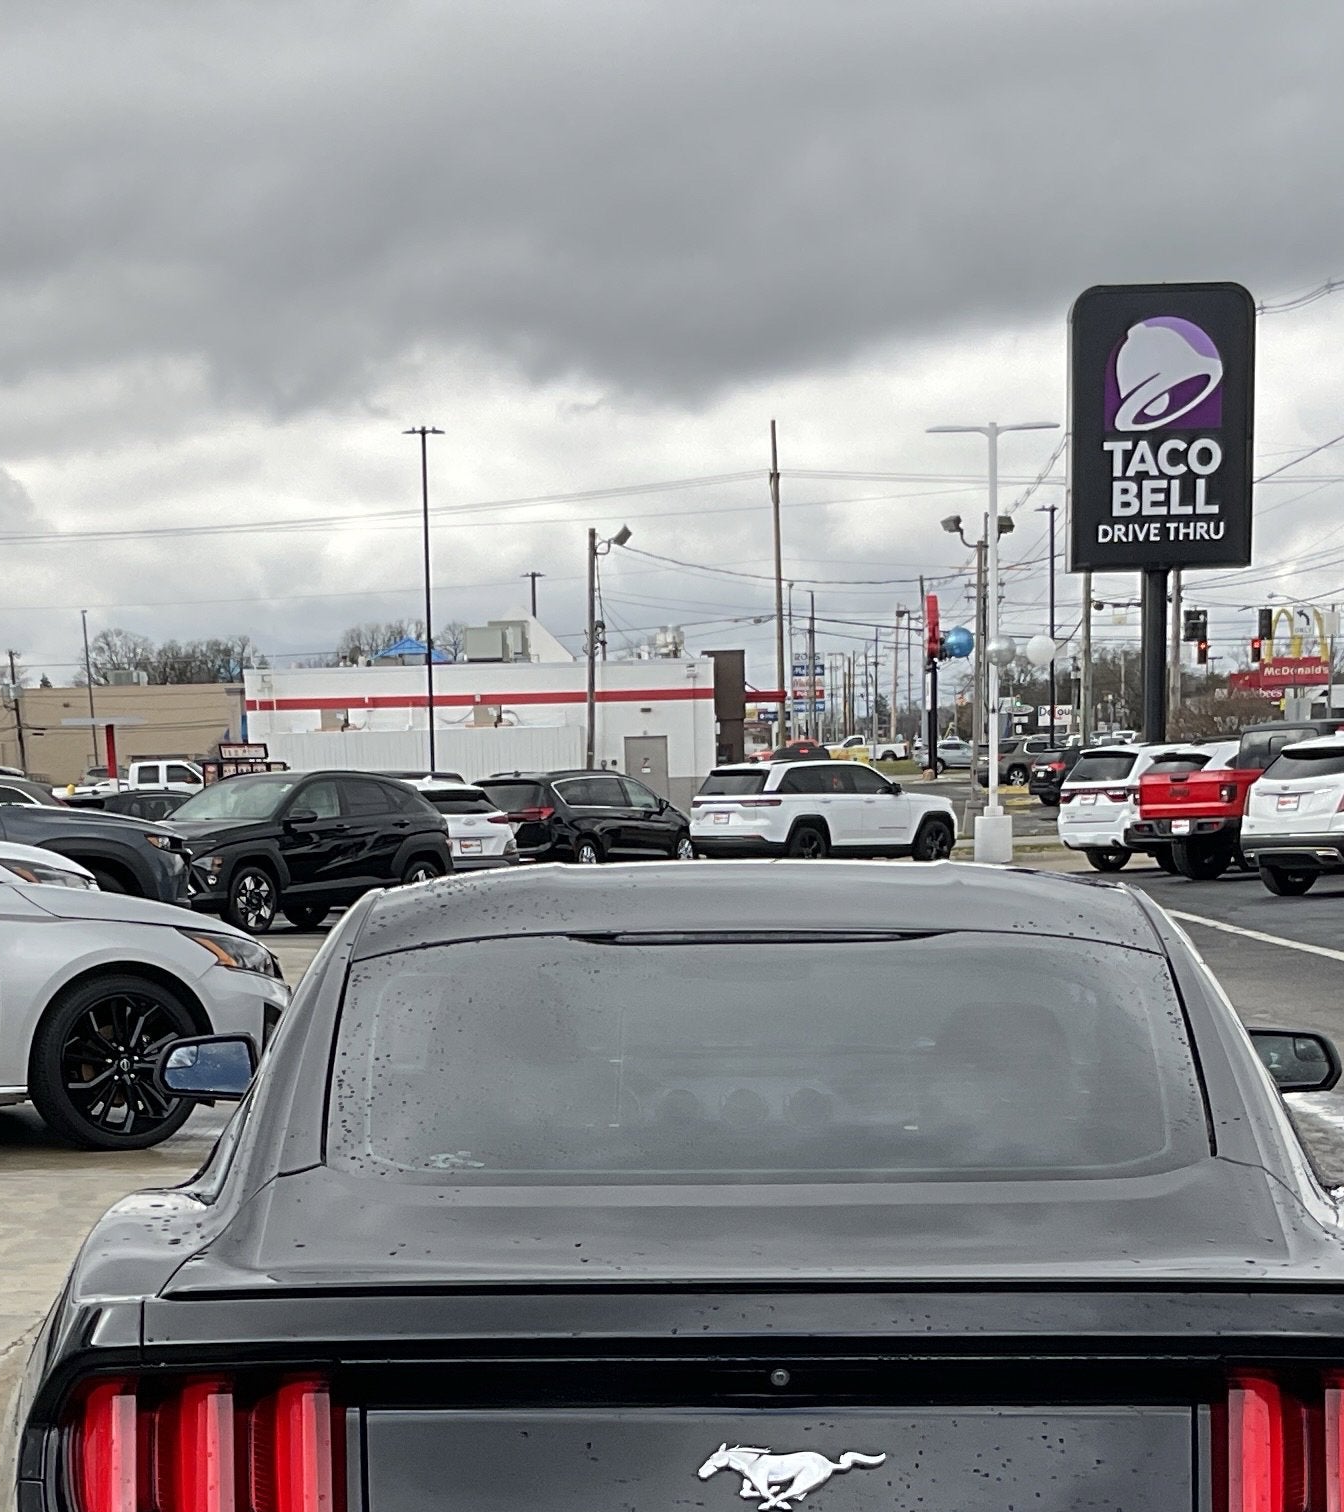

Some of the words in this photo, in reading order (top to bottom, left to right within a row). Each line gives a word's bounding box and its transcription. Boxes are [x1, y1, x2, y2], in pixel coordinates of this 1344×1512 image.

[1103, 438, 1223, 478] TACO
[1111, 478, 1219, 517] BELL
[1097, 523, 1161, 543] DRIVE
[1166, 521, 1225, 541] THRU
[1264, 665, 1329, 677] McDonald's
